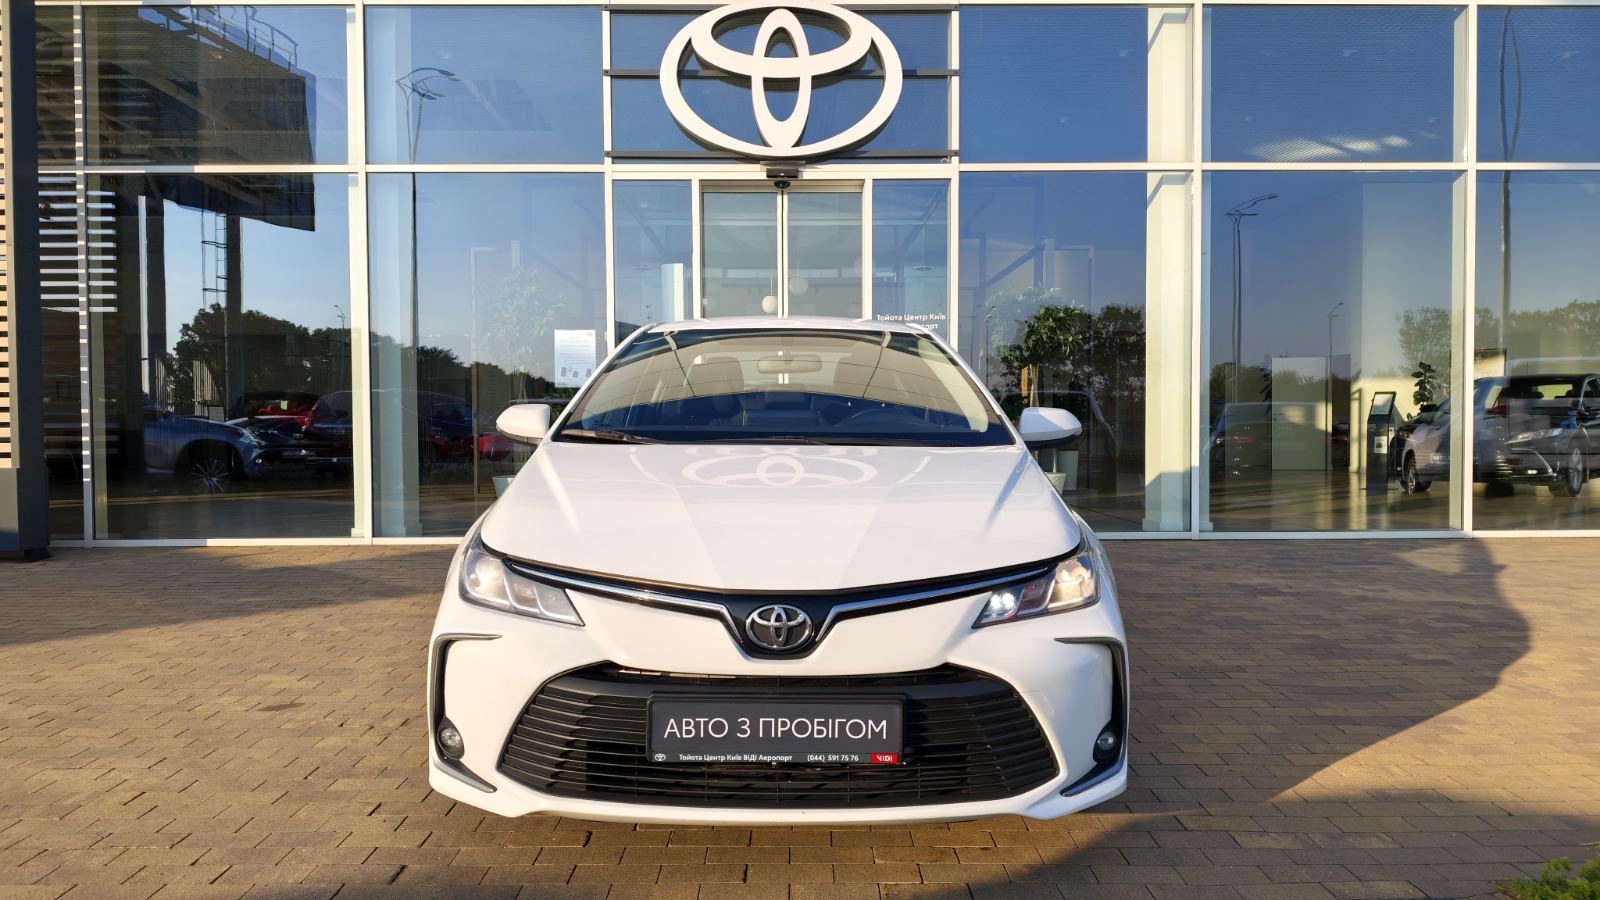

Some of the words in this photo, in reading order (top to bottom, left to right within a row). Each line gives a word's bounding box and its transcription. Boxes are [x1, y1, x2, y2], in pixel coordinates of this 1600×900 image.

[663, 717, 729, 738] АВТО
[736, 717, 751, 738] З
[759, 718, 888, 740] ПРОБІГОМ
[703, 754, 726, 762] Центр
[743, 754, 757, 762] ВІДІ
[758, 754, 793, 763] Аеропорт
[807, 754, 825, 762] (044)
